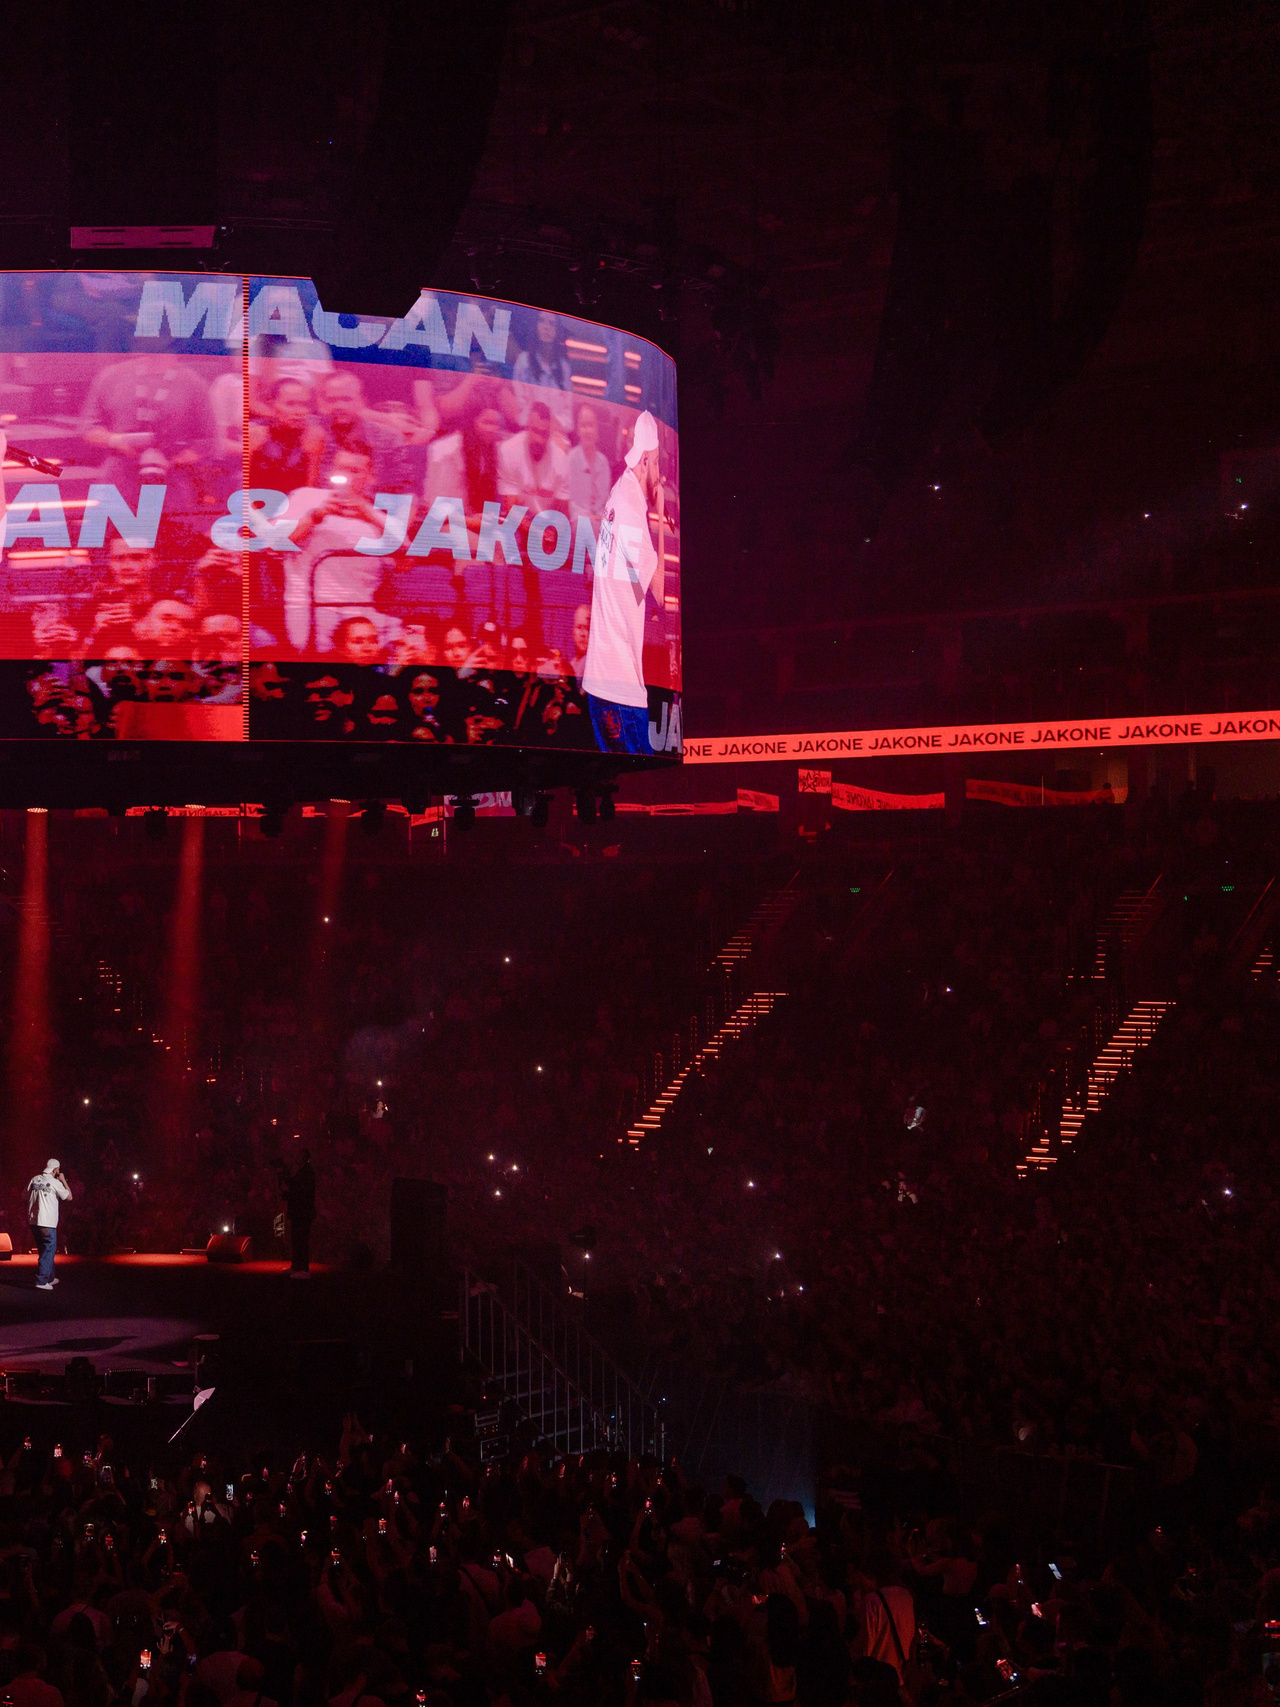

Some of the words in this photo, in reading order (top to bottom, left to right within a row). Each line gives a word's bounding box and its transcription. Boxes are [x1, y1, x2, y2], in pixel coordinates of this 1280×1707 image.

[134, 280, 512, 364] MACAN
[210, 487, 302, 552] &
[354, 491, 644, 585] JAKONE
[718, 741, 787, 756] JAKONE
[792, 738, 863, 753] JAKONE
[868, 734, 942, 750] JAKONE
[947, 730, 1025, 747] JAKONE
[1030, 726, 1111, 743] JAKONE
[1118, 722, 1203, 739] JAKONE
